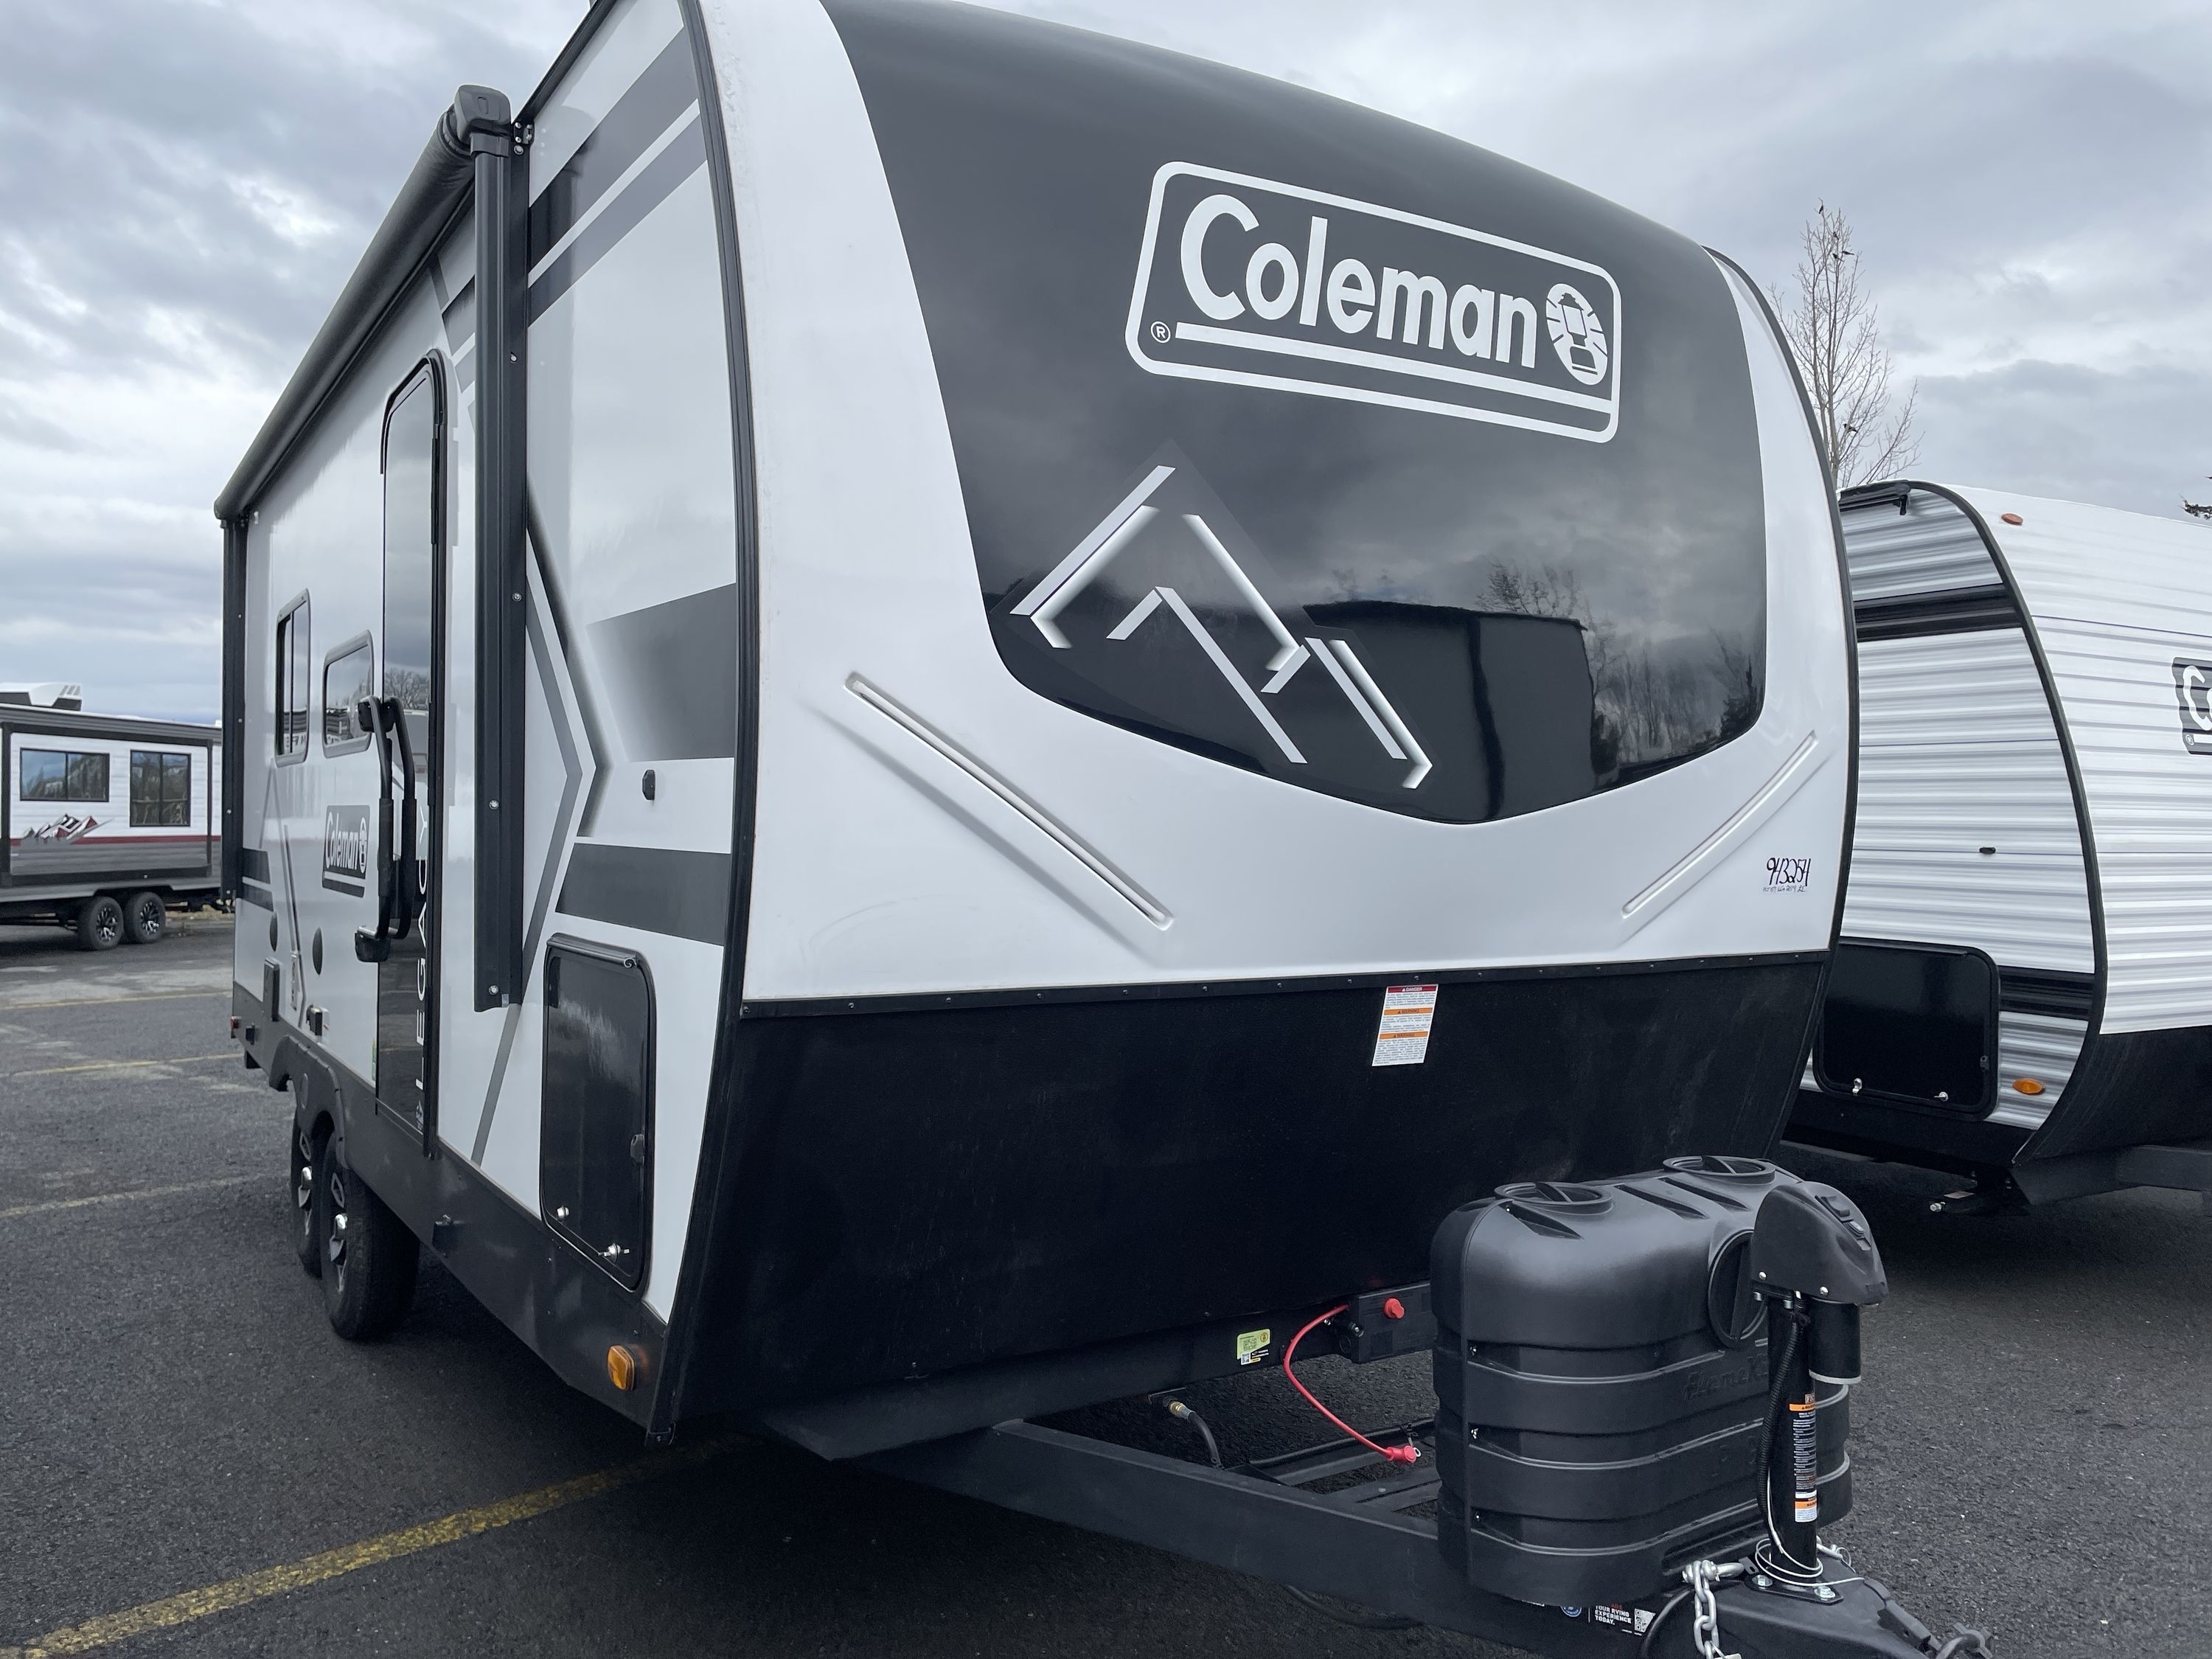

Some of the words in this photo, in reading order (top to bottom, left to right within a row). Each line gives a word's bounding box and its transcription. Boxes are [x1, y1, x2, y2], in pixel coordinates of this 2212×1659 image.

[1180, 194, 1537, 369] Coleman
[2183, 666, 2212, 731] C
[325, 812, 359, 870] Coleman
[415, 805, 428, 1091] LEGACY
[1595, 1610, 1632, 1624] EXPERIENCE
[1595, 1615, 1615, 1625] TODAY.
